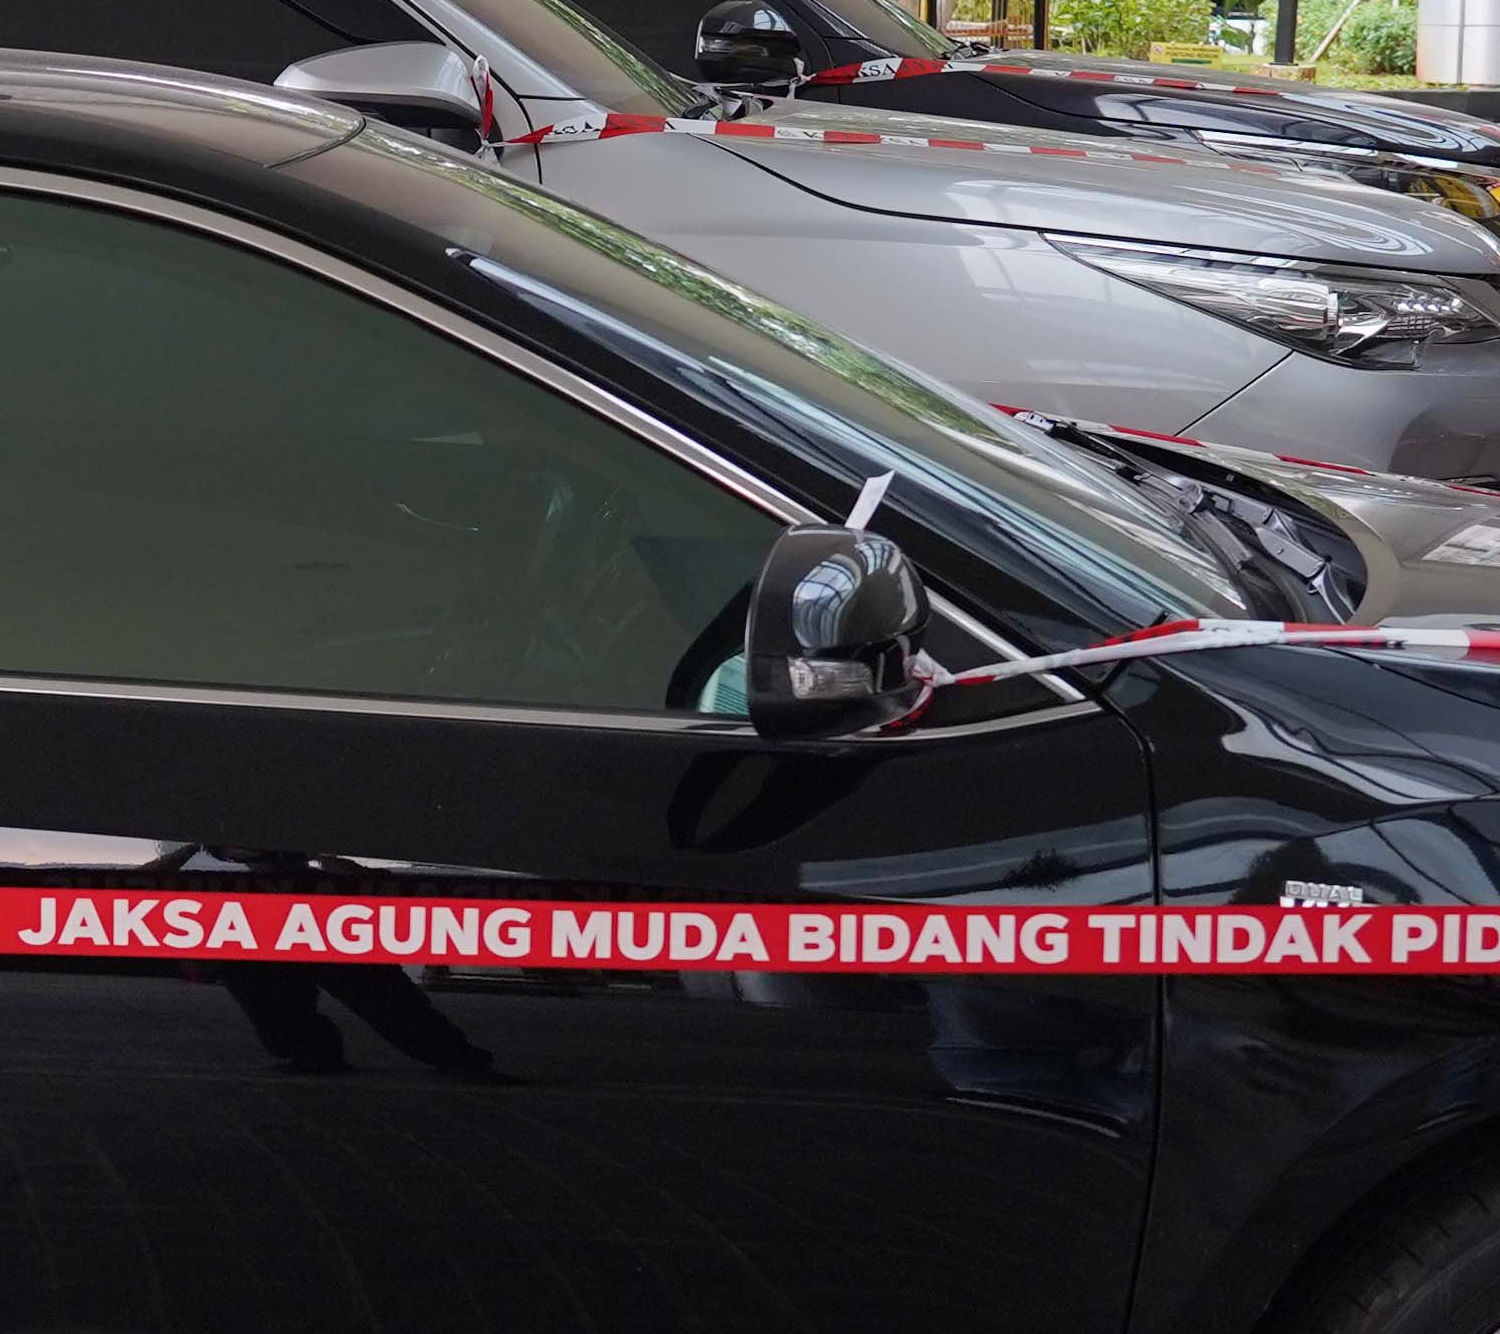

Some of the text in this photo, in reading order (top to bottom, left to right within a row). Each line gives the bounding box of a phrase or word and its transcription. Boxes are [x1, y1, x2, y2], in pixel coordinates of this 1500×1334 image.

[18, 897, 258, 950] JAKSA
[274, 903, 531, 958] AGUNG
[551, 911, 770, 962] MUDA
[788, 913, 1069, 964] BIDANG
[1088, 914, 1372, 964] TINDAK
